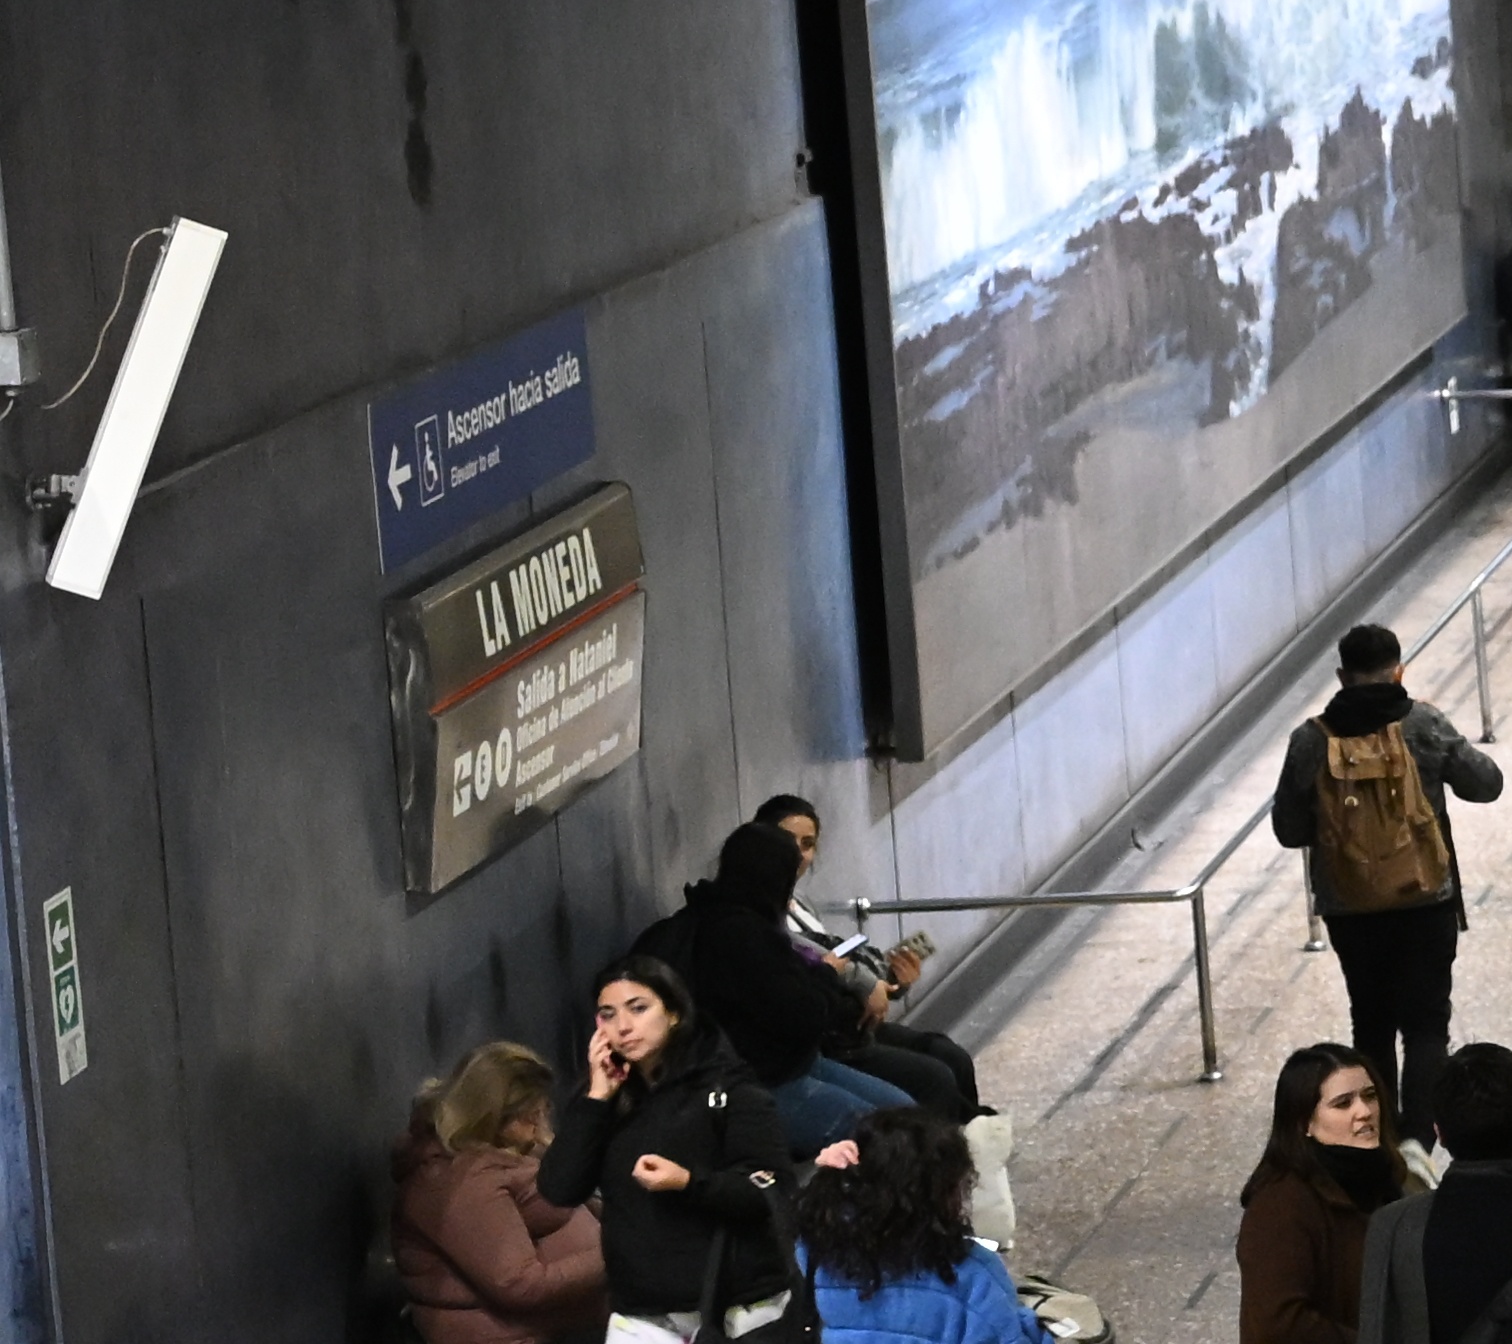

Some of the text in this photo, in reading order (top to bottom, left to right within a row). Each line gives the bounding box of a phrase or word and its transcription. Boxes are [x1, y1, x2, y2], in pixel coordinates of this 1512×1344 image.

[447, 350, 582, 449] Ascensor hacia salida
[475, 527, 603, 657] LA MONEDA
[517, 622, 618, 719] Salida a Nataniel
